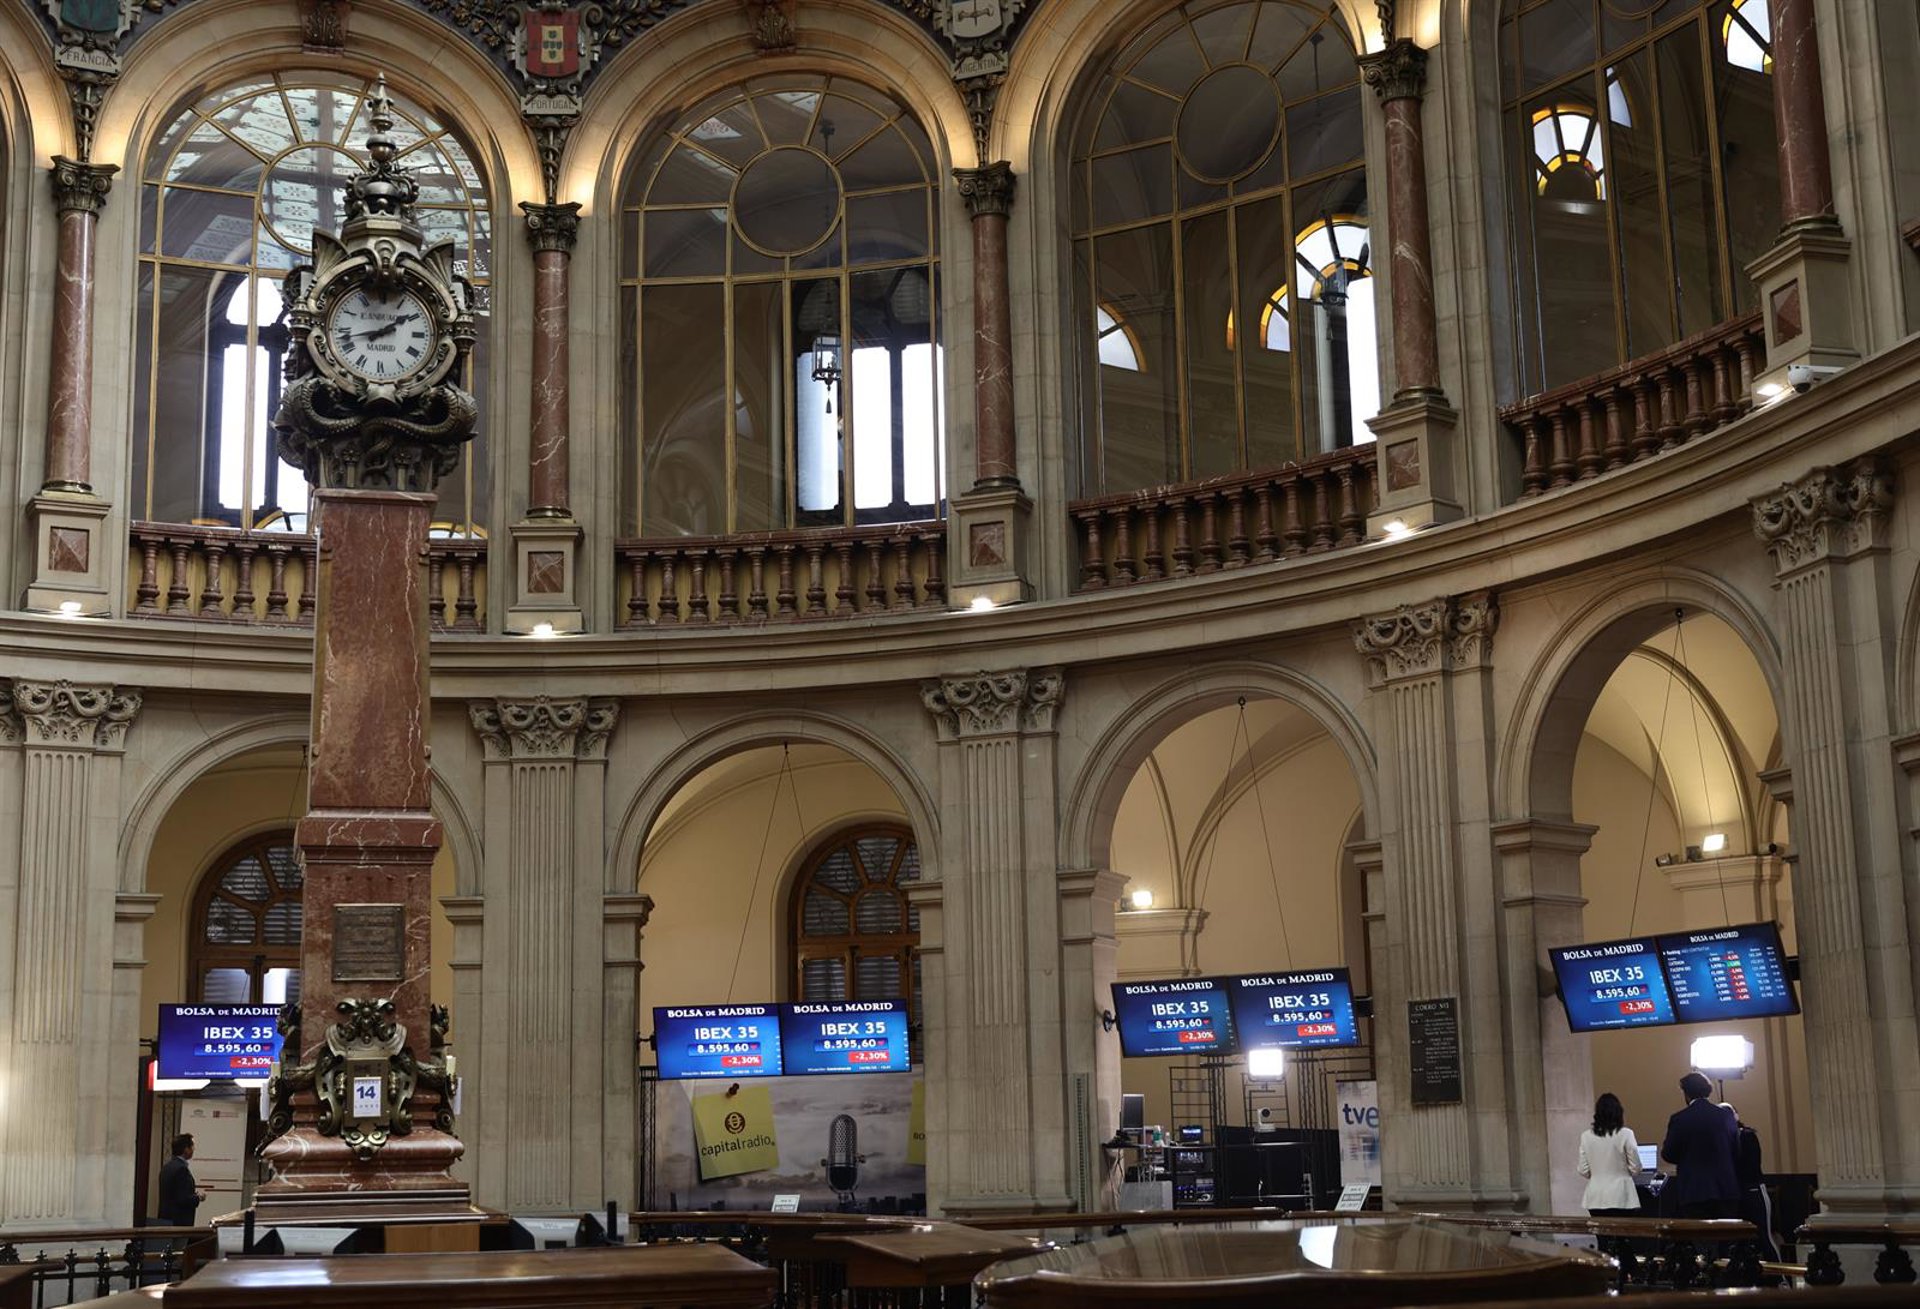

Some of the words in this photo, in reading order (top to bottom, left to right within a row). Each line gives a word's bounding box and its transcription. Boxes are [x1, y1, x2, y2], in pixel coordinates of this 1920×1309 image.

[65, 51, 113, 67] FRANCIA
[530, 99, 574, 110] PORTUGAL
[366, 343, 396, 352] MADRID
[1689, 935, 1709, 943] BOLSA
[1715, 931, 1739, 940] MADRID
[1562, 950, 1593, 960] BOLSA
[1603, 943, 1644, 955] MADRID
[1241, 977, 1275, 987] BOLSA
[1288, 973, 1334, 984] MADRID
[1589, 968, 1623, 984] IBEX
[1625, 966, 1644, 980] 35
[1125, 985, 1157, 994] BOLSA
[1170, 981, 1213, 991] MADRID
[1596, 986, 1640, 999] 8.595,60
[1268, 995, 1306, 1008] IBEX
[1309, 993, 1330, 1006] 35
[175, 1007, 216, 1016] BOLSA
[667, 1008, 704, 1018] BOLSA
[718, 1007, 765, 1017] MADRID
[793, 1004, 830, 1014] BOLSA
[845, 1002, 894, 1012] MADRID
[1152, 1002, 1186, 1016] IBEX
[1190, 1001, 1210, 1013] 35
[1156, 1018, 1203, 1029] 8.595,60
[1273, 1011, 1323, 1023] 8.595,60
[203, 1026, 245, 1039] IBEX
[251, 1026, 273, 1039] 35
[694, 1026, 732, 1040] IBEX
[737, 1026, 759, 1038] 35
[821, 1022, 859, 1036] IBEX
[865, 1021, 887, 1034] 35
[204, 1043, 262, 1054] 8.595,60
[697, 1043, 749, 1054] 8.595,60
[823, 1039, 877, 1050] 8.595,60
[356, 1085, 376, 1099] 14
[1342, 1103, 1380, 1128] tve
